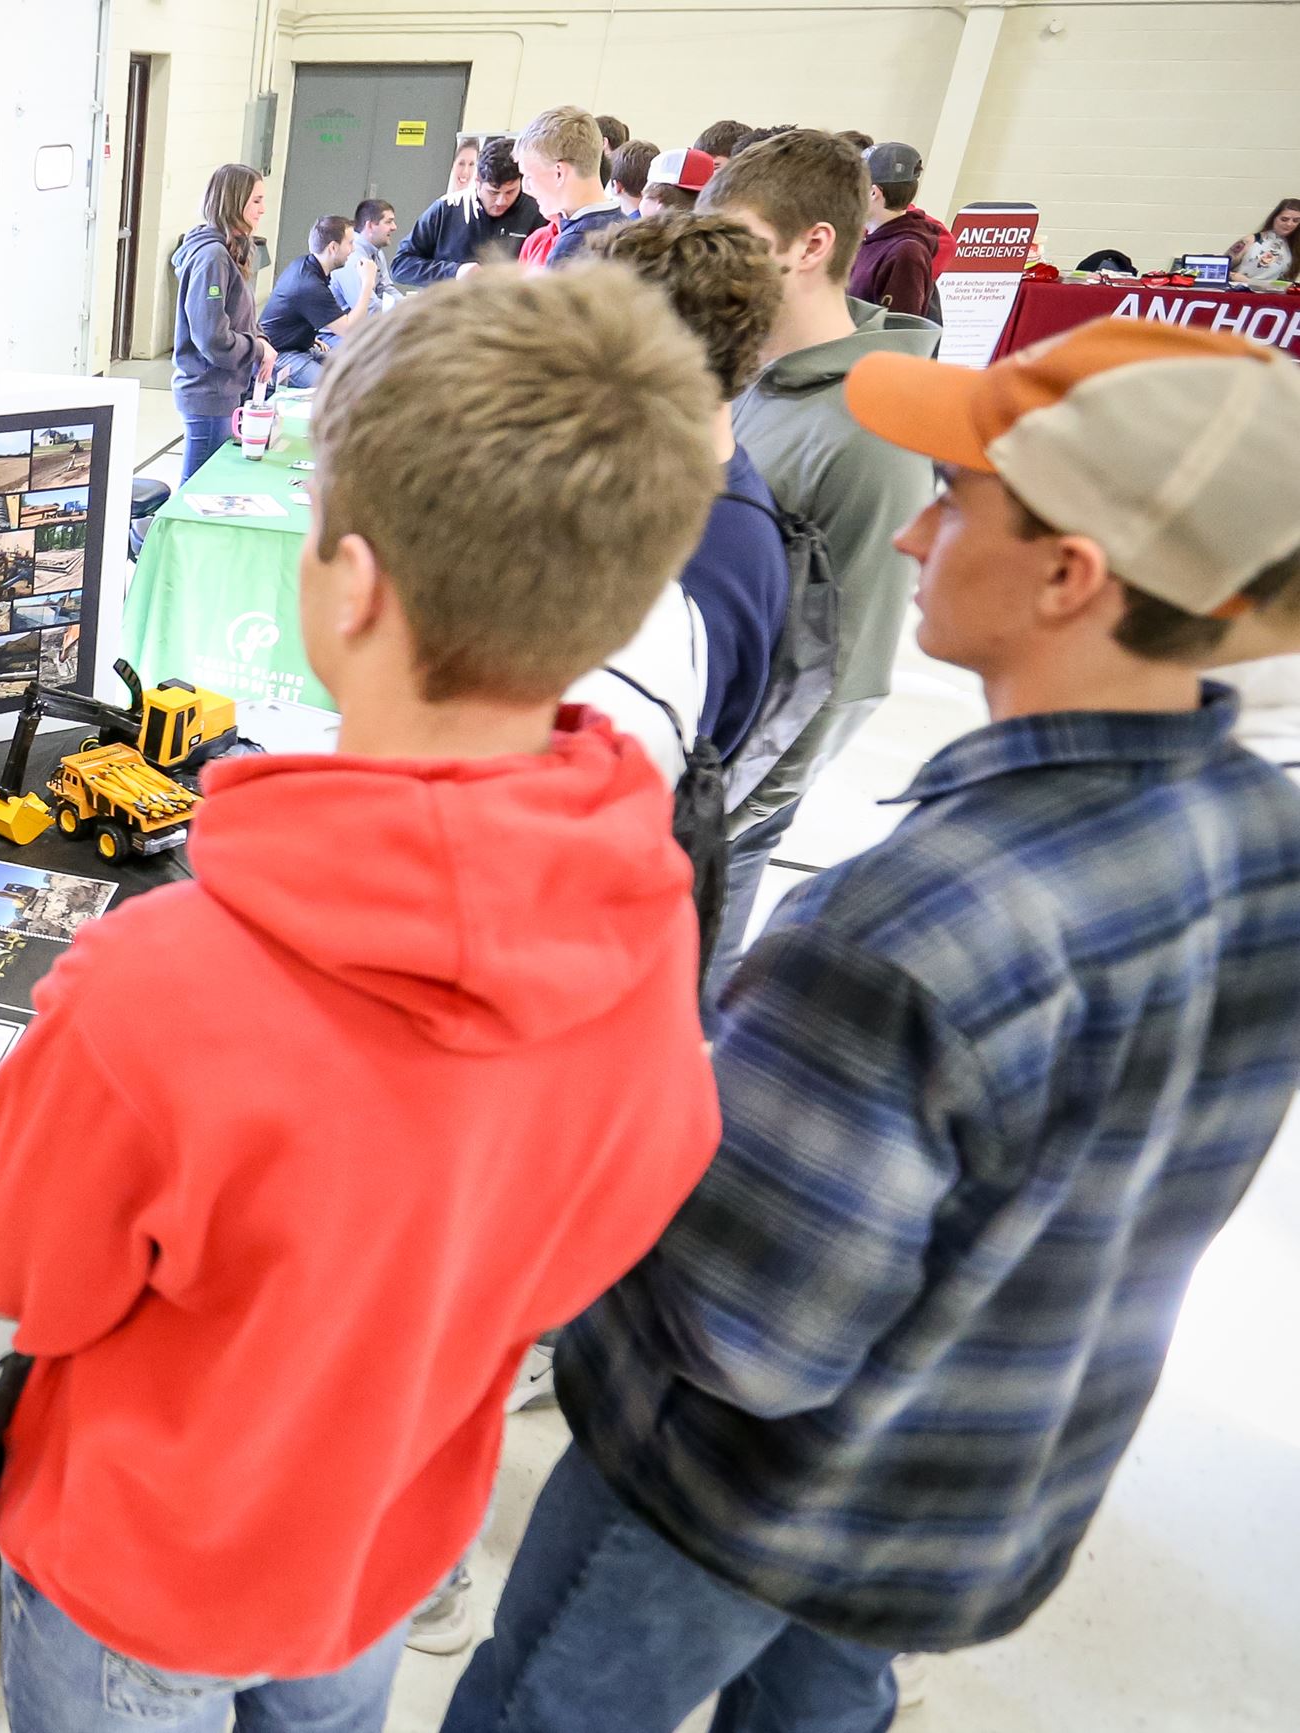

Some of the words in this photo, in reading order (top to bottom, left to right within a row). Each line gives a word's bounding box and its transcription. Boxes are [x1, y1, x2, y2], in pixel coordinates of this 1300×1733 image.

[956, 227, 1031, 244] ANCHOR
[955, 246, 1026, 258] NGREDIENTS
[251, 667, 305, 687] PLAINS
